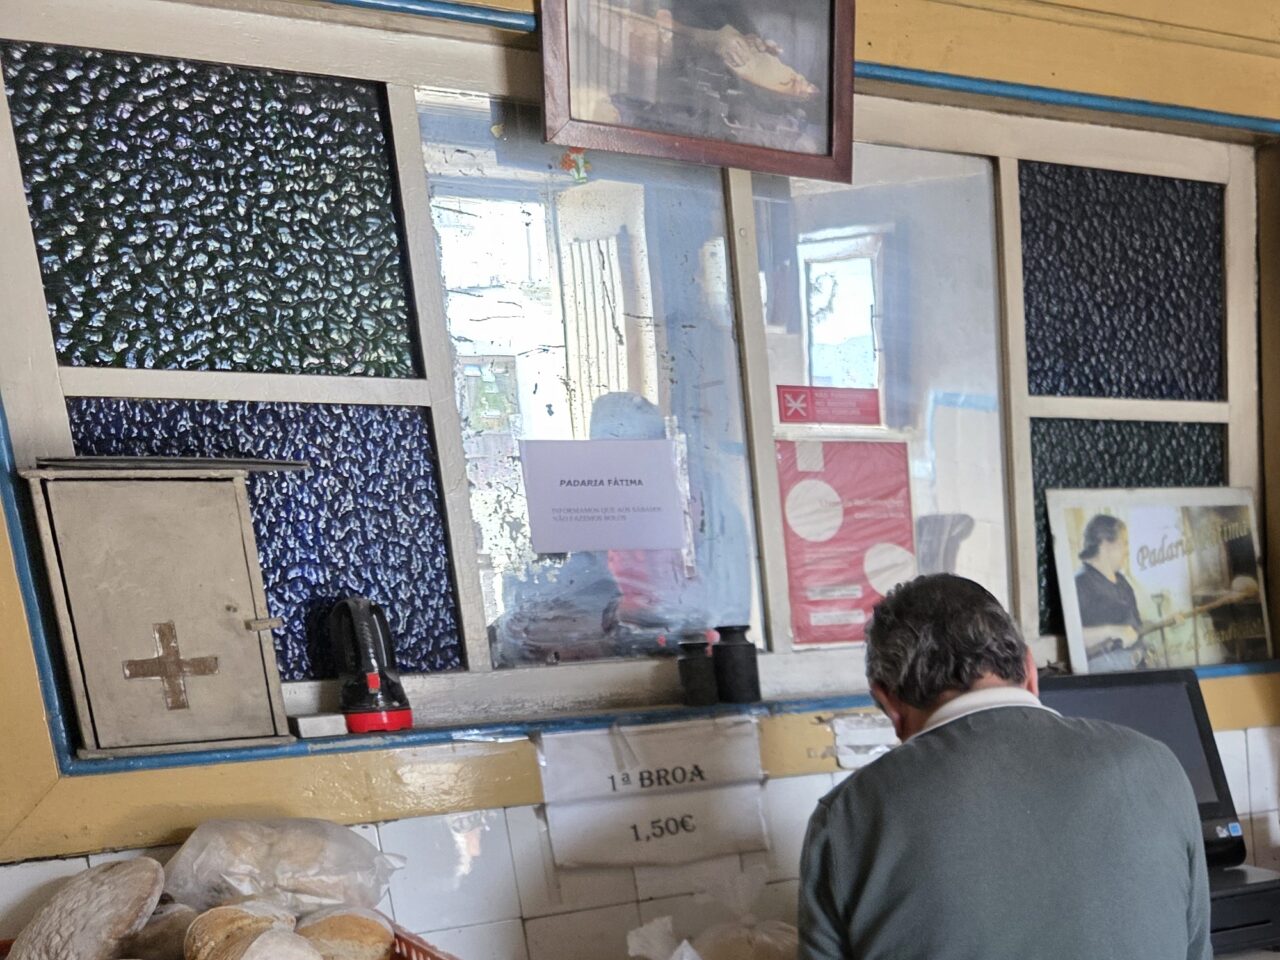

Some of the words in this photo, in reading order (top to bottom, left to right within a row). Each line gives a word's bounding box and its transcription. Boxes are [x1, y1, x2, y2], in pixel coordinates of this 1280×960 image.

[559, 479, 605, 487] PADARIA
[639, 764, 706, 788] BROA
[630, 814, 697, 842] 1,50€
